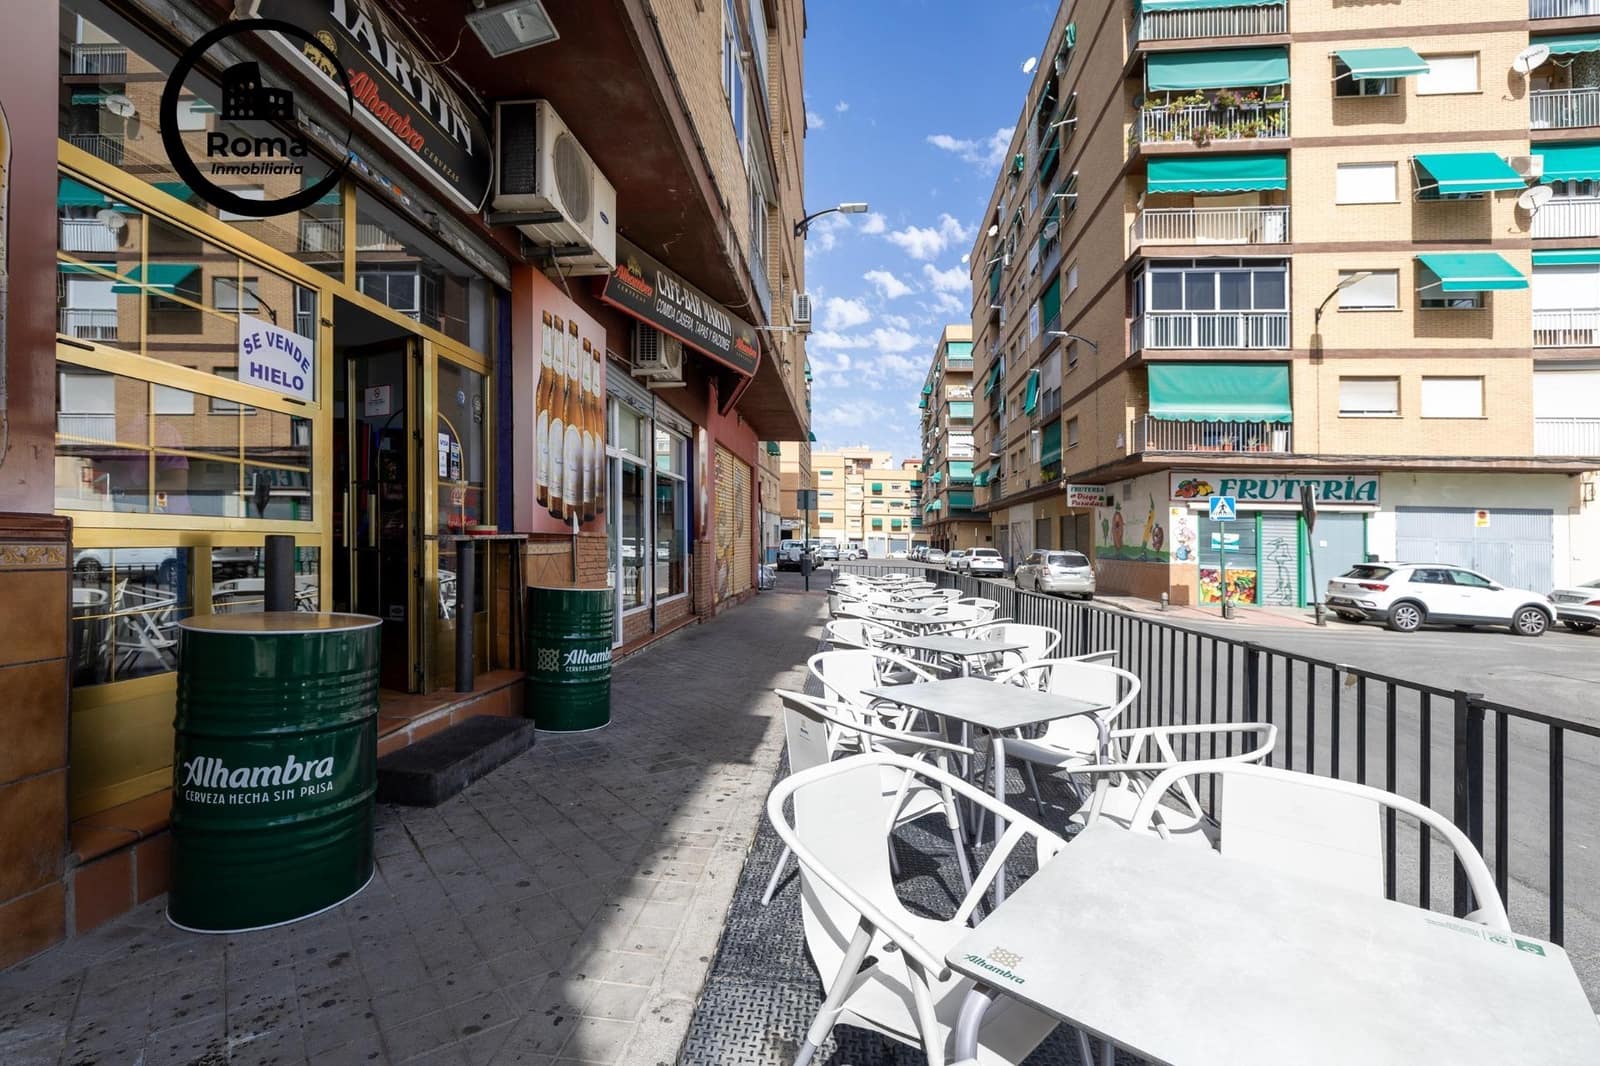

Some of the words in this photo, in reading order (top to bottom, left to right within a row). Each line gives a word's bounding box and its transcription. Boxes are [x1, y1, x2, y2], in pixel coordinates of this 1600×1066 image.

[343, 68, 425, 153] Alhambra
[423, 147, 461, 184] CERVEZAS
[243, 333, 262, 355] SE
[265, 331, 310, 374] VENDE
[250, 361, 304, 391] HIELO
[182, 755, 334, 789] Alhambra
[185, 789, 225, 805] CERVEZA
[229, 792, 270, 805] HECHA
[273, 789, 295, 801] SIN
[300, 780, 333, 797] PRISA
[963, 953, 1025, 985] Alhambra
